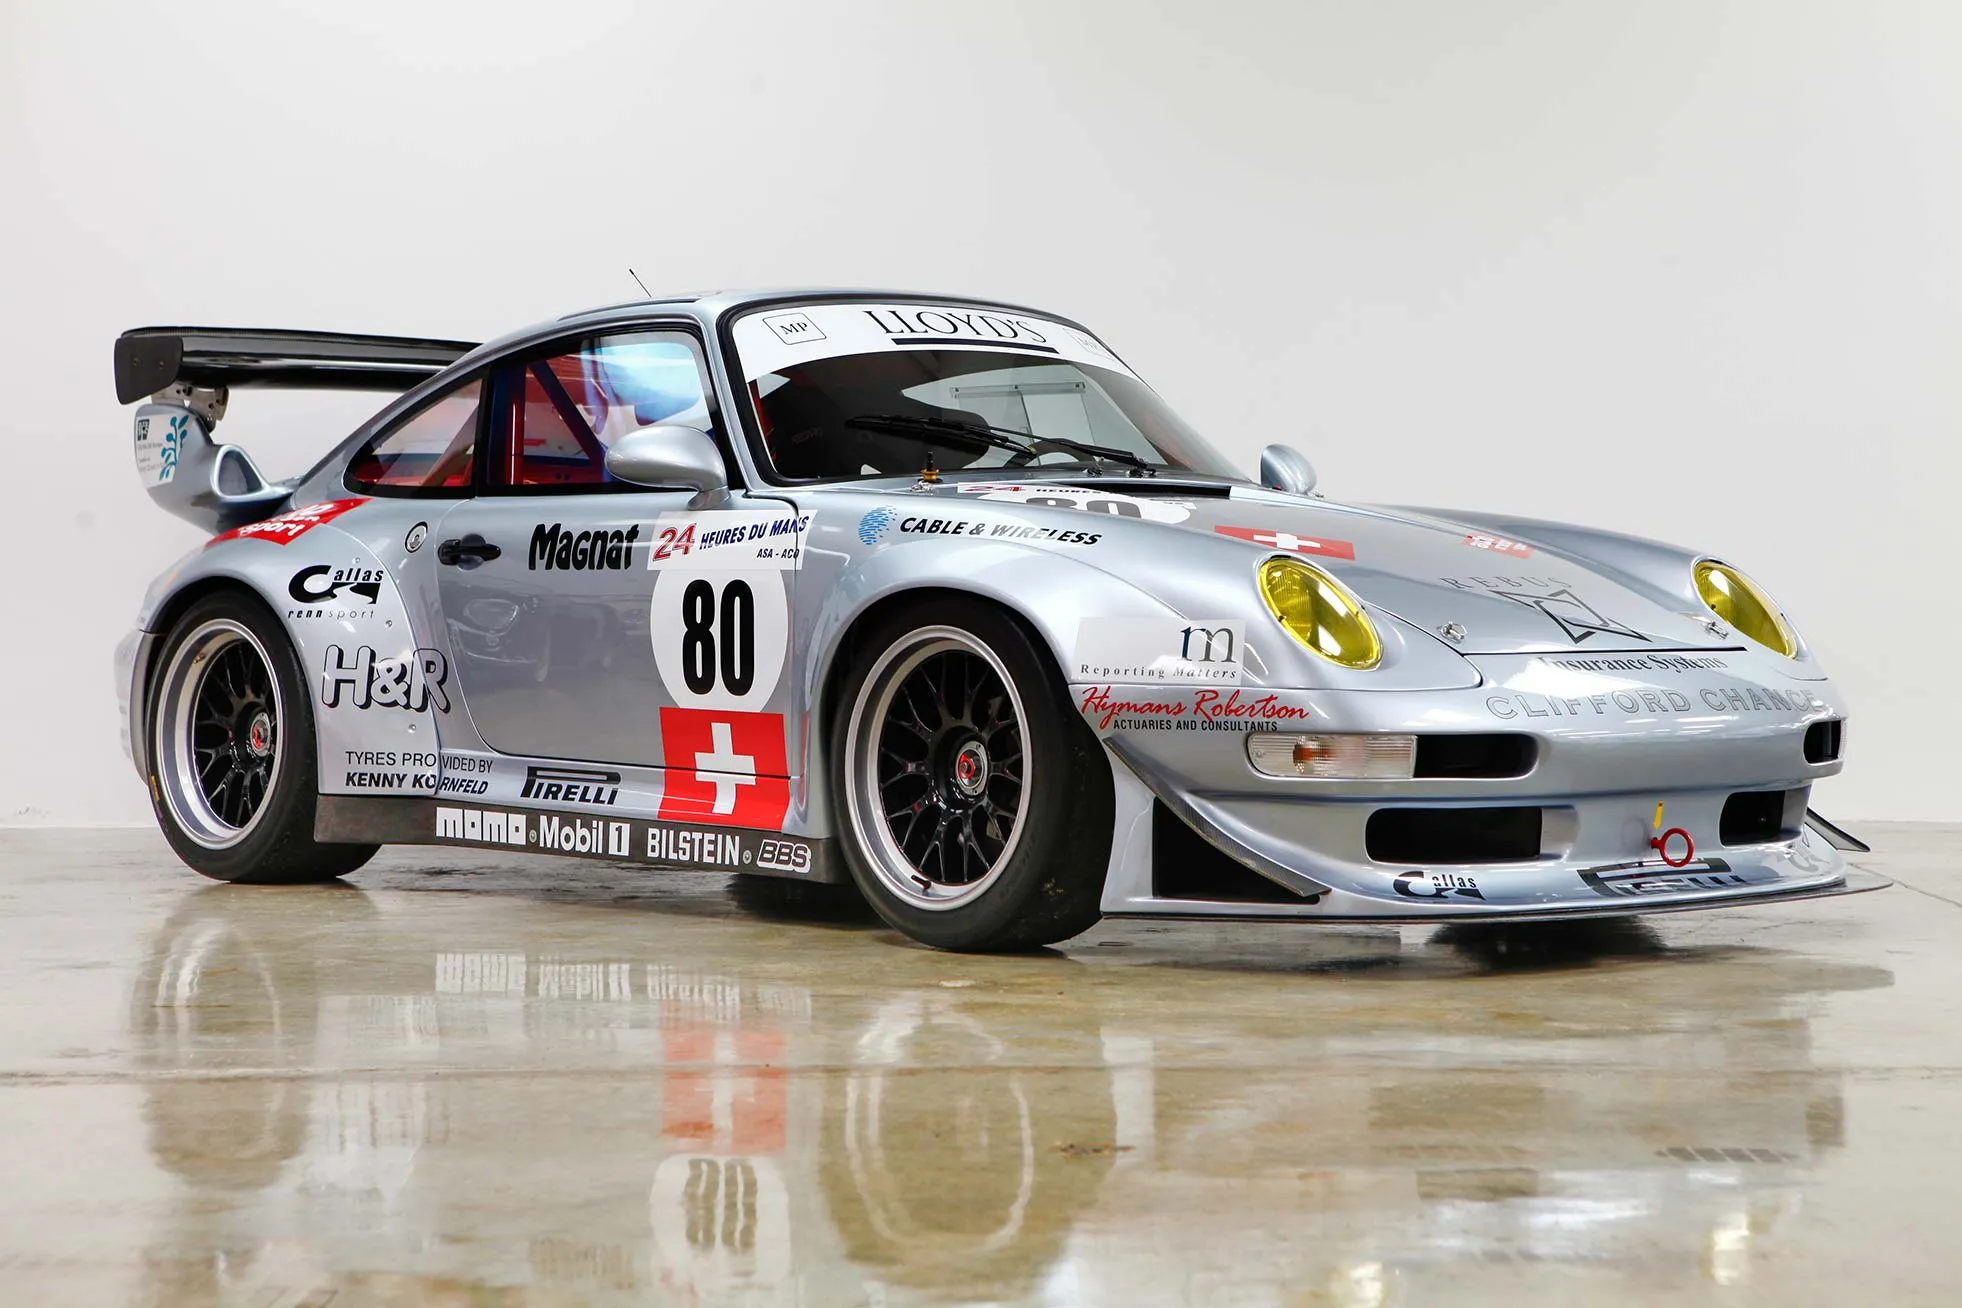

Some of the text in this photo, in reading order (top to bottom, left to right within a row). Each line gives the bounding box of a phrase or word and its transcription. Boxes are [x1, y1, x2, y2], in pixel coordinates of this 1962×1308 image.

[779, 322, 808, 335] MP
[863, 310, 1047, 344] LLOYD'S
[528, 523, 640, 571] Magnat
[652, 515, 810, 562] 24 HEURES DU MANS
[900, 517, 1103, 545] CABLE & WIRELESS
[757, 548, 773, 559] ASA
[781, 548, 800, 559] ACO
[289, 565, 384, 604] Callas
[1439, 576, 1572, 589] REBUS
[288, 609, 375, 620] renn sport
[682, 579, 755, 697] 80
[322, 644, 451, 714] H&R
[1080, 664, 1237, 680] Reporting Matters
[1647, 654, 1729, 674] Systems
[1081, 685, 1310, 730] Hymans Robertson
[1485, 688, 1822, 720] CLIFFORD CHANCE
[1113, 719, 1278, 732] ACTUARIES AND CONSULTANTS
[345, 751, 493, 773] TYRES PROVIDED BY
[345, 772, 489, 795] KENNY KORNFELD
[520, 766, 622, 805] PIRELLI
[539, 814, 631, 857] Mobil 1
[647, 827, 740, 867] BILSTEIN
[757, 839, 812, 874] BBS
